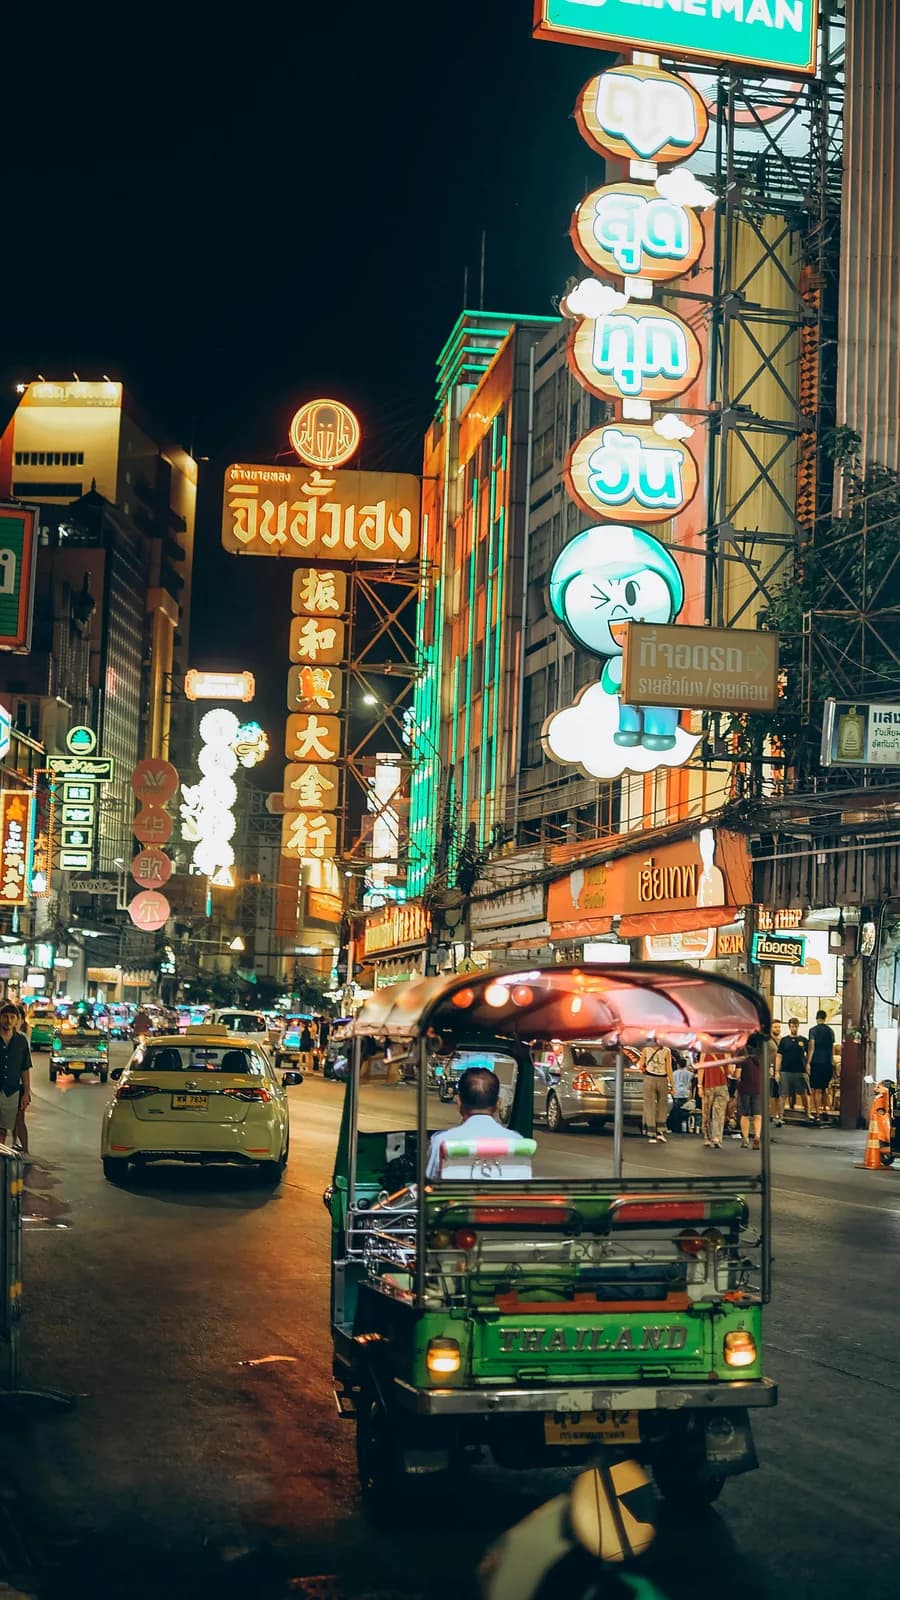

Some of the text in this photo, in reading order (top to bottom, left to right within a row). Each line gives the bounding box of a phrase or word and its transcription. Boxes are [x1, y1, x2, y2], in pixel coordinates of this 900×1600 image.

[598, 198, 686, 267] สุด
[592, 433, 680, 504] วัน
[639, 630, 743, 673] ที่จอดรถ
[499, 1326, 689, 1352] THAILAND
